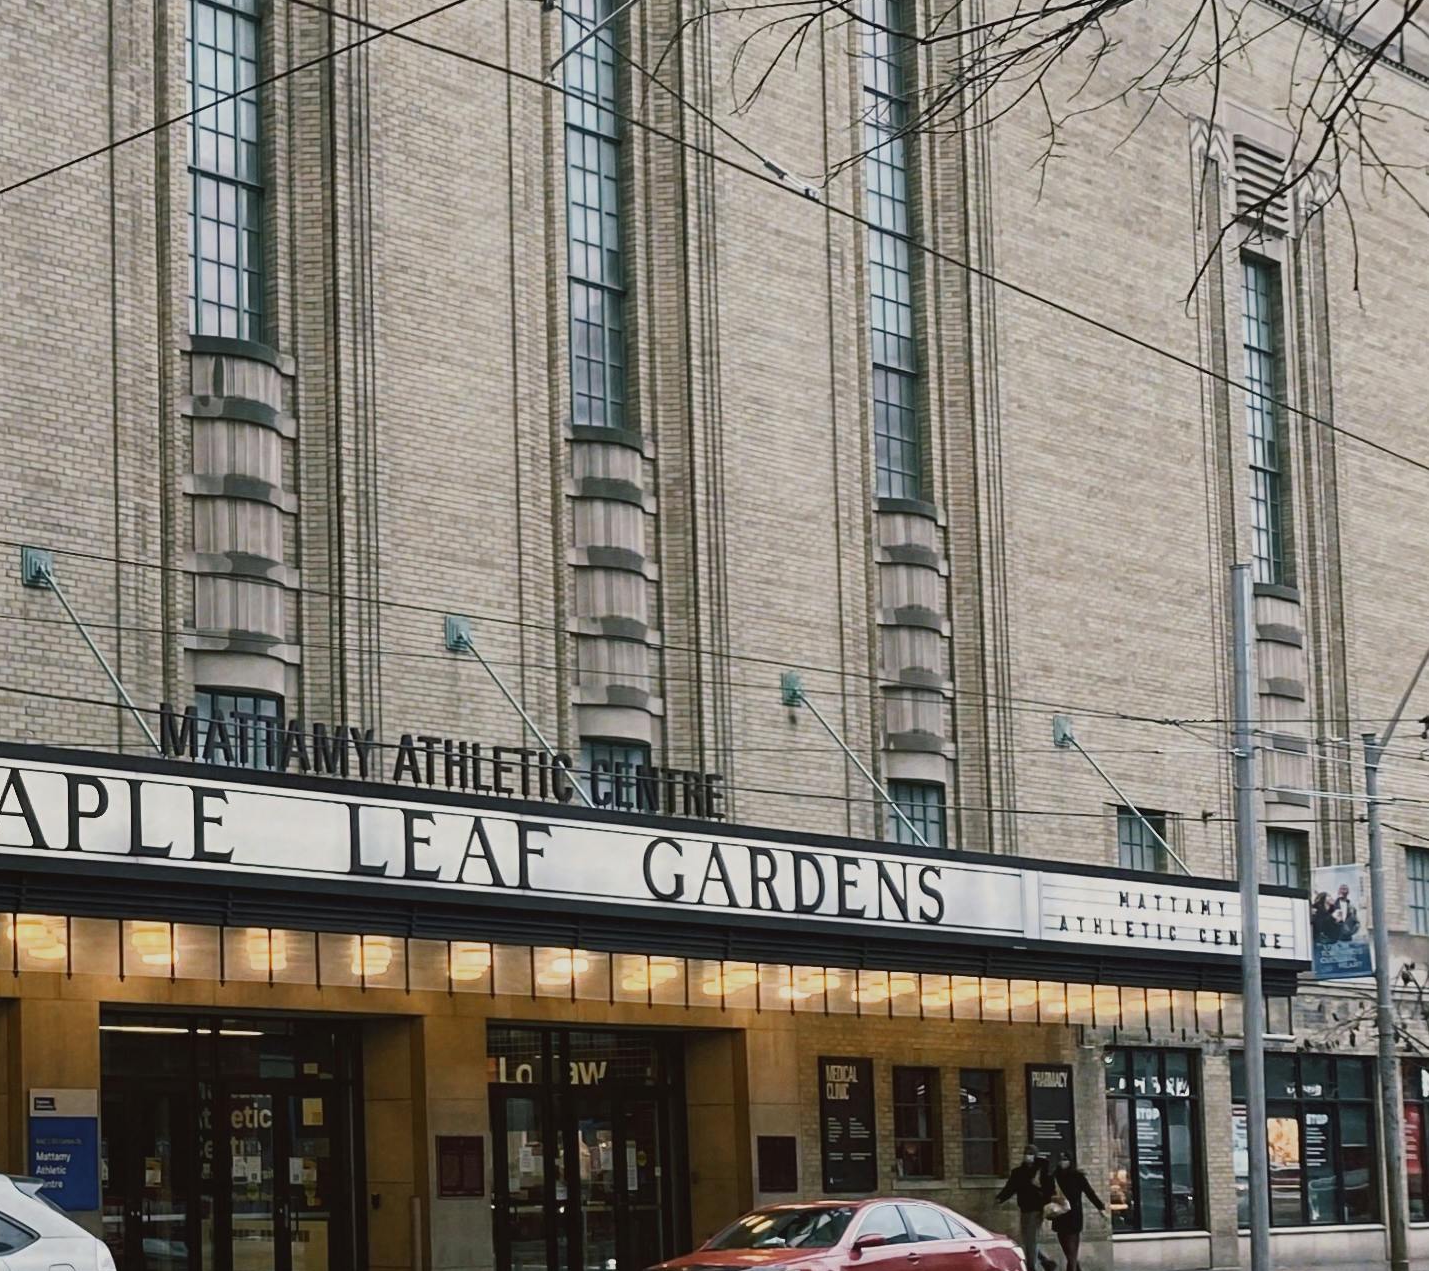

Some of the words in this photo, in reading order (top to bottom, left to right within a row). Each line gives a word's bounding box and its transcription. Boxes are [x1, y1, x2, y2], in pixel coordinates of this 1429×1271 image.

[159, 702, 371, 779] MATTAMY
[392, 734, 572, 803] ATHLETIC
[589, 759, 726, 822] CENTRE
[347, 802, 553, 890] LEAF
[642, 836, 945, 925] GARDENS
[1118, 891, 1227, 917] MATTAMY
[1059, 914, 1177, 941] ATHLETIC
[1199, 928, 1281, 949] CENRE
[825, 1065, 858, 1082] MEDICAL
[826, 1083, 849, 1099] CLINIC
[36, 1151, 71, 1162] Mattamy
[36, 1164, 66, 1175] Athletic
